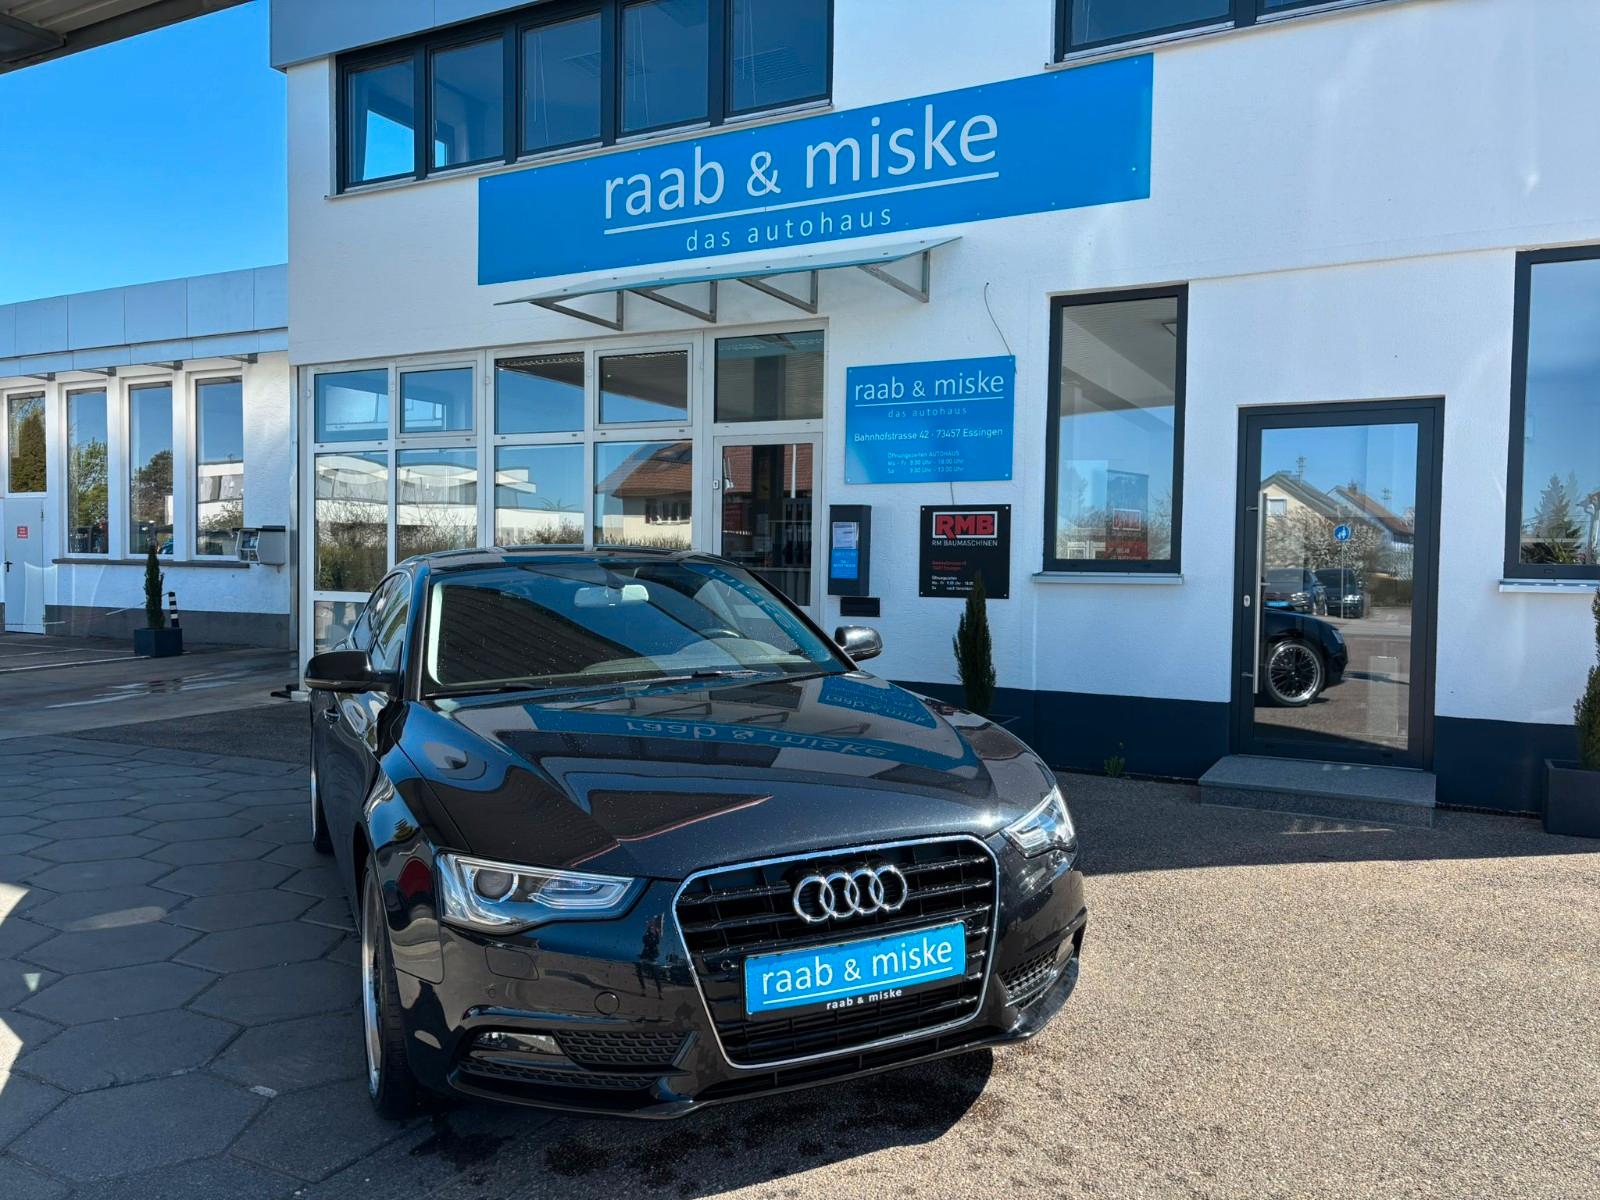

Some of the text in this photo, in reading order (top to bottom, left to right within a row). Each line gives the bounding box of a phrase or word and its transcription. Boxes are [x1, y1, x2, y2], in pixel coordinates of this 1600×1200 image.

[605, 104, 998, 219] raab & miske
[686, 207, 891, 252] das autohaus
[855, 370, 1005, 401] raab & miske
[888, 407, 968, 418] das autohaus
[854, 432, 918, 442] Bahnhofstrasse
[919, 430, 929, 439] 42
[936, 429, 961, 438] 73457
[963, 428, 1003, 439] Essingen
[935, 514, 994, 540] RMB
[763, 937, 952, 995] raab & miske
[826, 998, 853, 1010] raab
[869, 988, 902, 1001] miske
